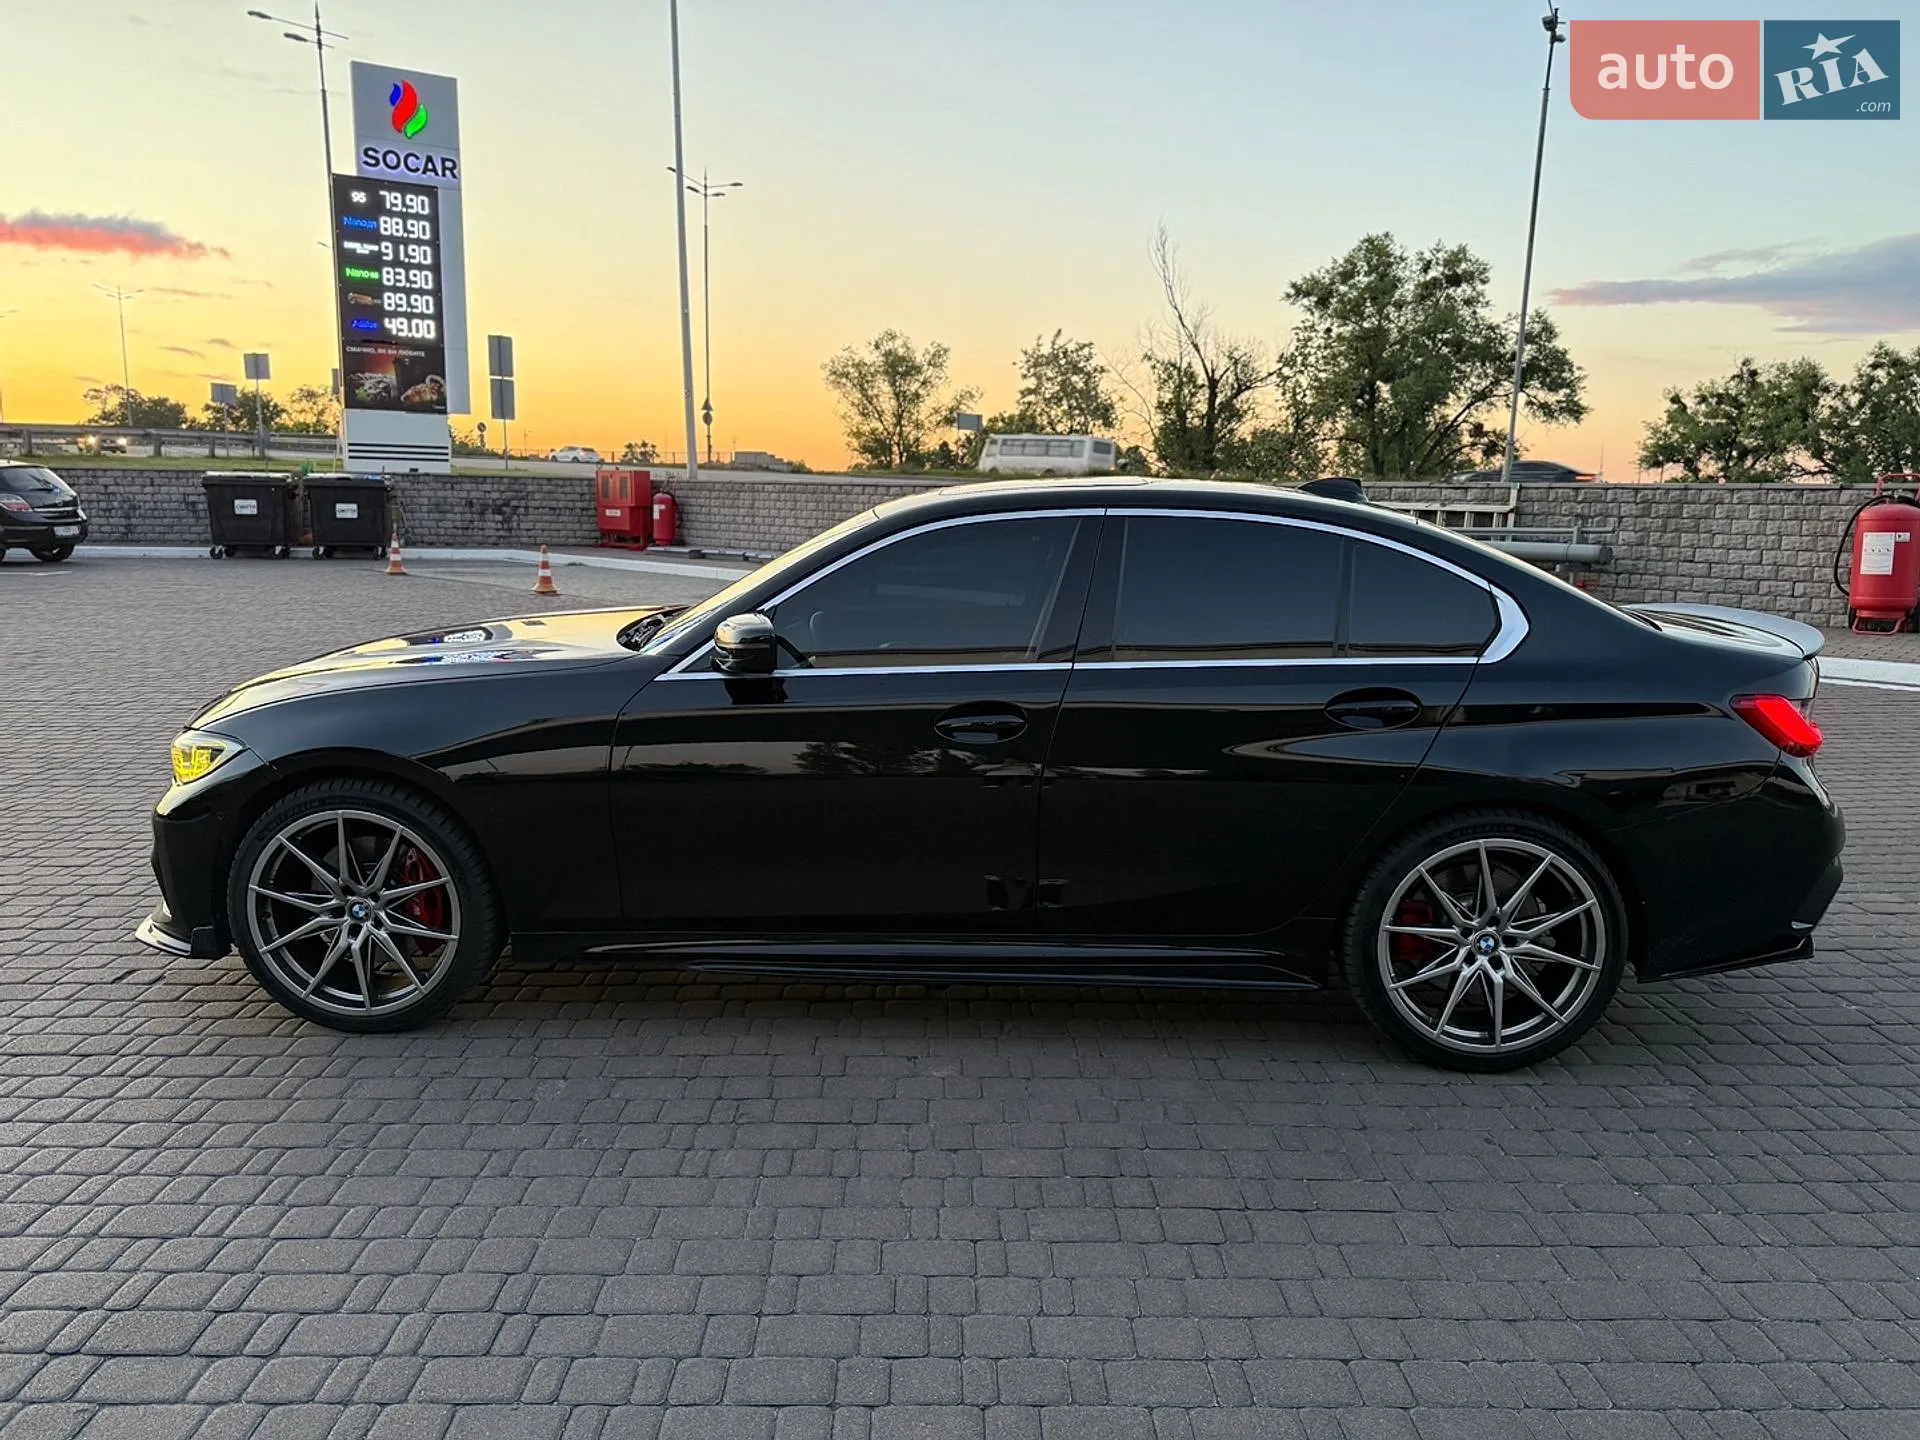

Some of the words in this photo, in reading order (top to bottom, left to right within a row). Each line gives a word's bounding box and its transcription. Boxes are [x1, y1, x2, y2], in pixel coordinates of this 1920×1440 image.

[361, 146, 459, 180] SOCAR
[351, 191, 367, 203] 95
[379, 190, 430, 215] 79.90
[380, 216, 431, 240] 88.90
[381, 241, 433, 265] 91.90
[382, 267, 433, 290] 83.90
[383, 292, 435, 314] 89.90
[384, 317, 437, 339] 49.00
